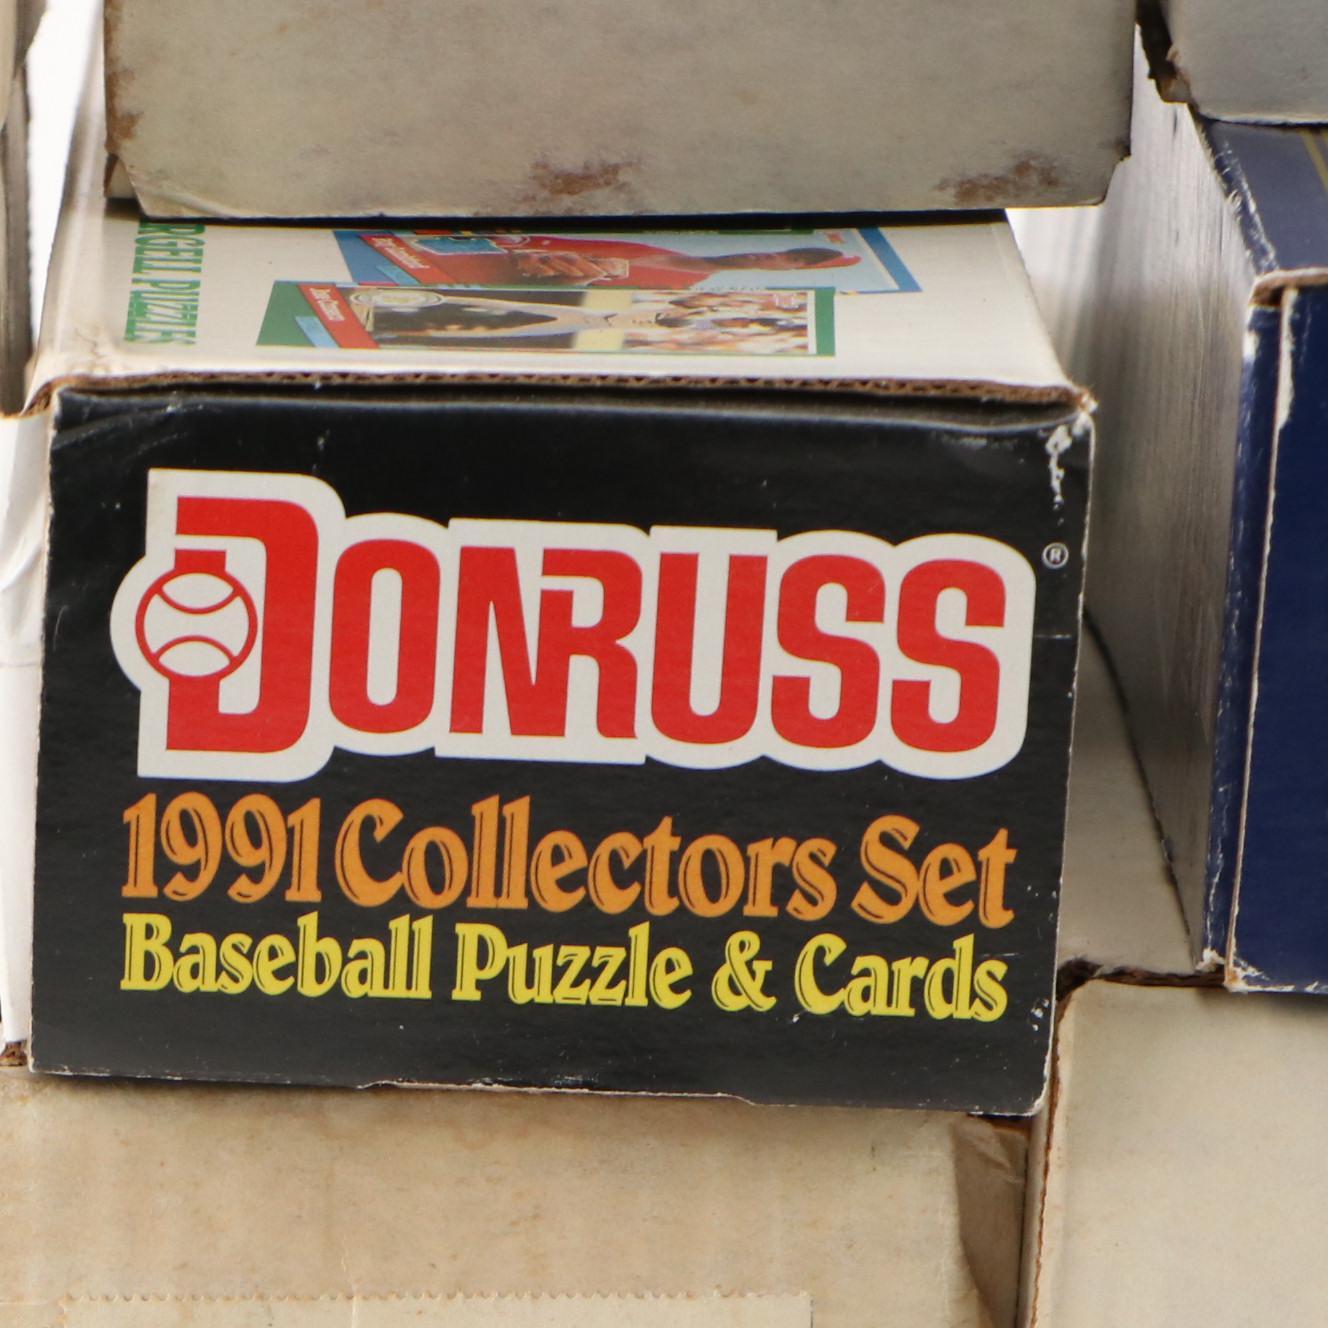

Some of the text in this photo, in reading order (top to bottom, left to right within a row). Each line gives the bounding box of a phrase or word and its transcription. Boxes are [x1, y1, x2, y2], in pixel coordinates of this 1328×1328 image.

[133, 220, 205, 273] RGELL
[117, 480, 1026, 770] DONRUSS
[121, 793, 1017, 929] 1991 Collectors Set
[121, 912, 1008, 1023] Baseball Puzzle & Cards
